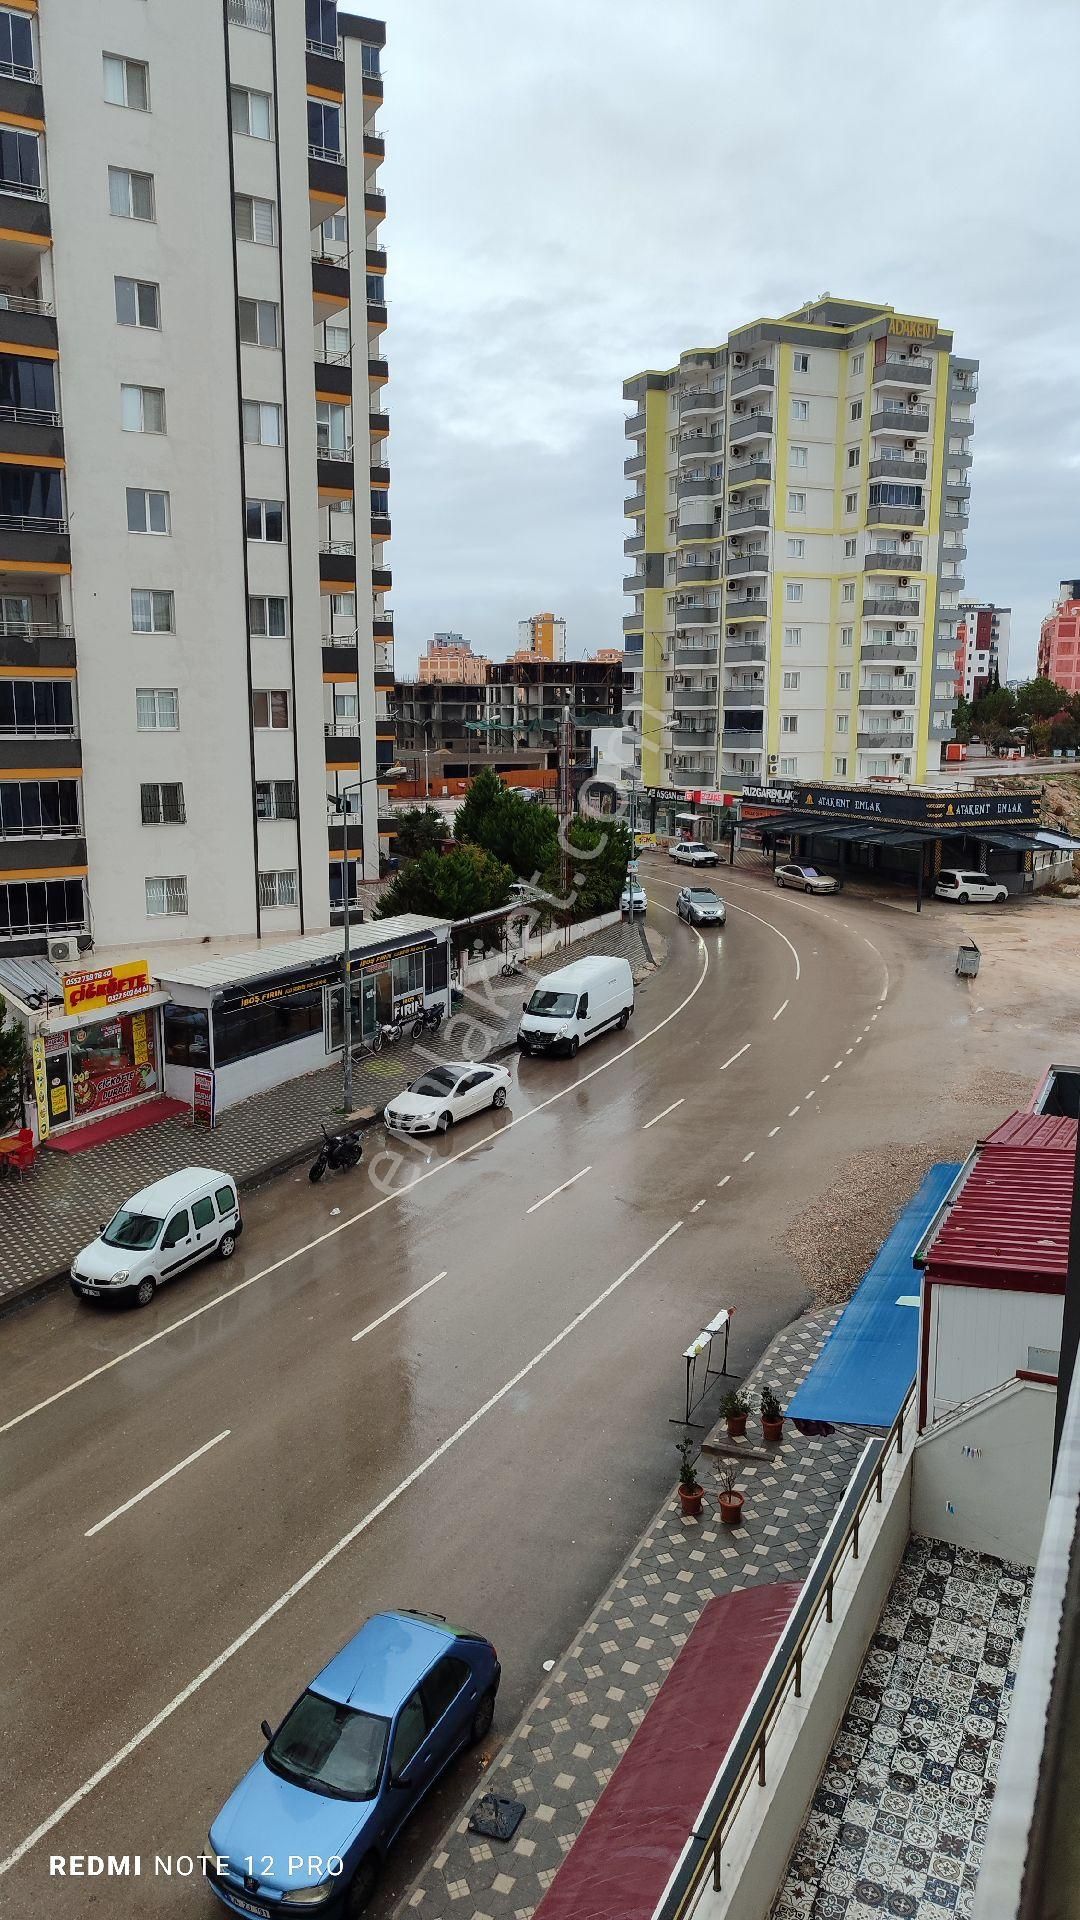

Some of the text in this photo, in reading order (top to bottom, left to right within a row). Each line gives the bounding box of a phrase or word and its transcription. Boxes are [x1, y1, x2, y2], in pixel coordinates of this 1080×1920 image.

[888, 318, 938, 339] ADAKENT
[818, 796, 882, 813] ATAKENT EMLAK
[956, 802, 1023, 815] ATAKENT EMLAK
[262, 989, 283, 1001] FIRIN
